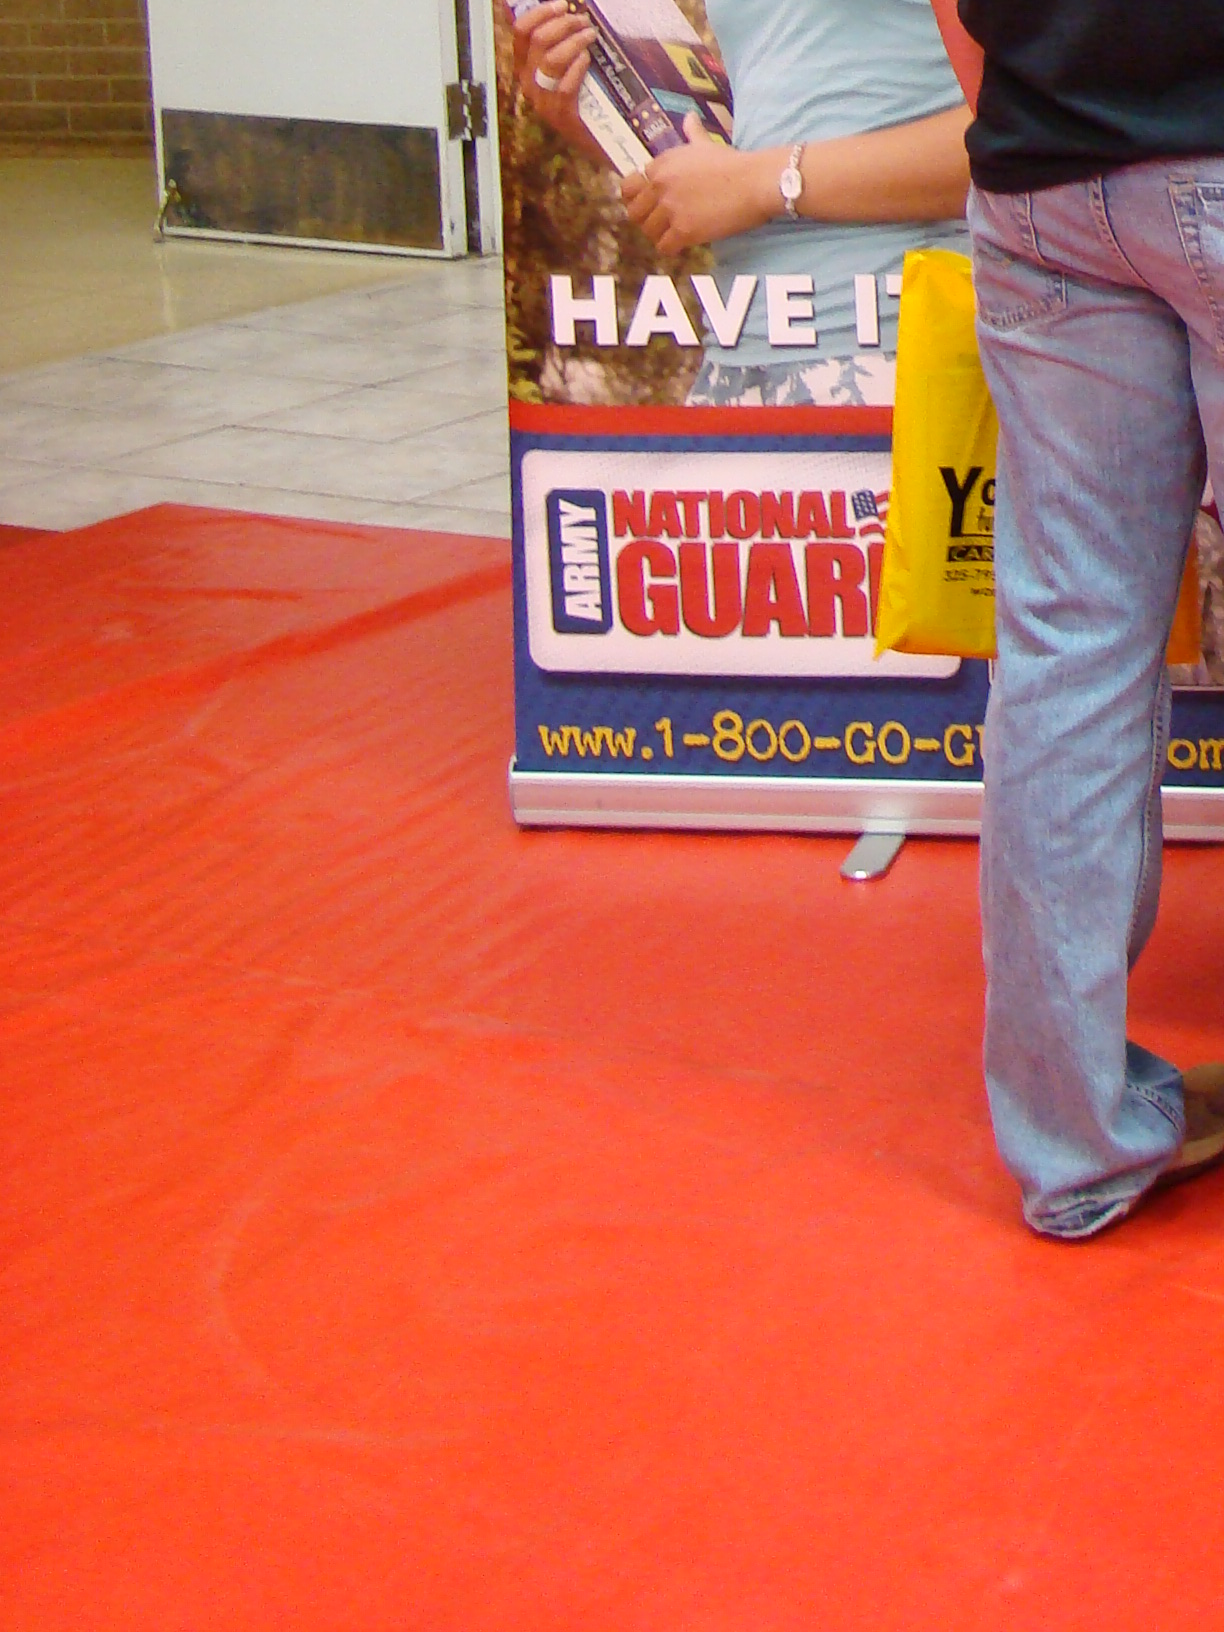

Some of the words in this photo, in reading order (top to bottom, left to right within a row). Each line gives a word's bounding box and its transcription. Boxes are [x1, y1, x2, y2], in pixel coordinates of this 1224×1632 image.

[550, 273, 818, 347] HAVE
[853, 273, 903, 347] I
[612, 489, 856, 540] NATIONAL
[558, 498, 604, 623] ARMY
[616, 541, 886, 638] GUAR
